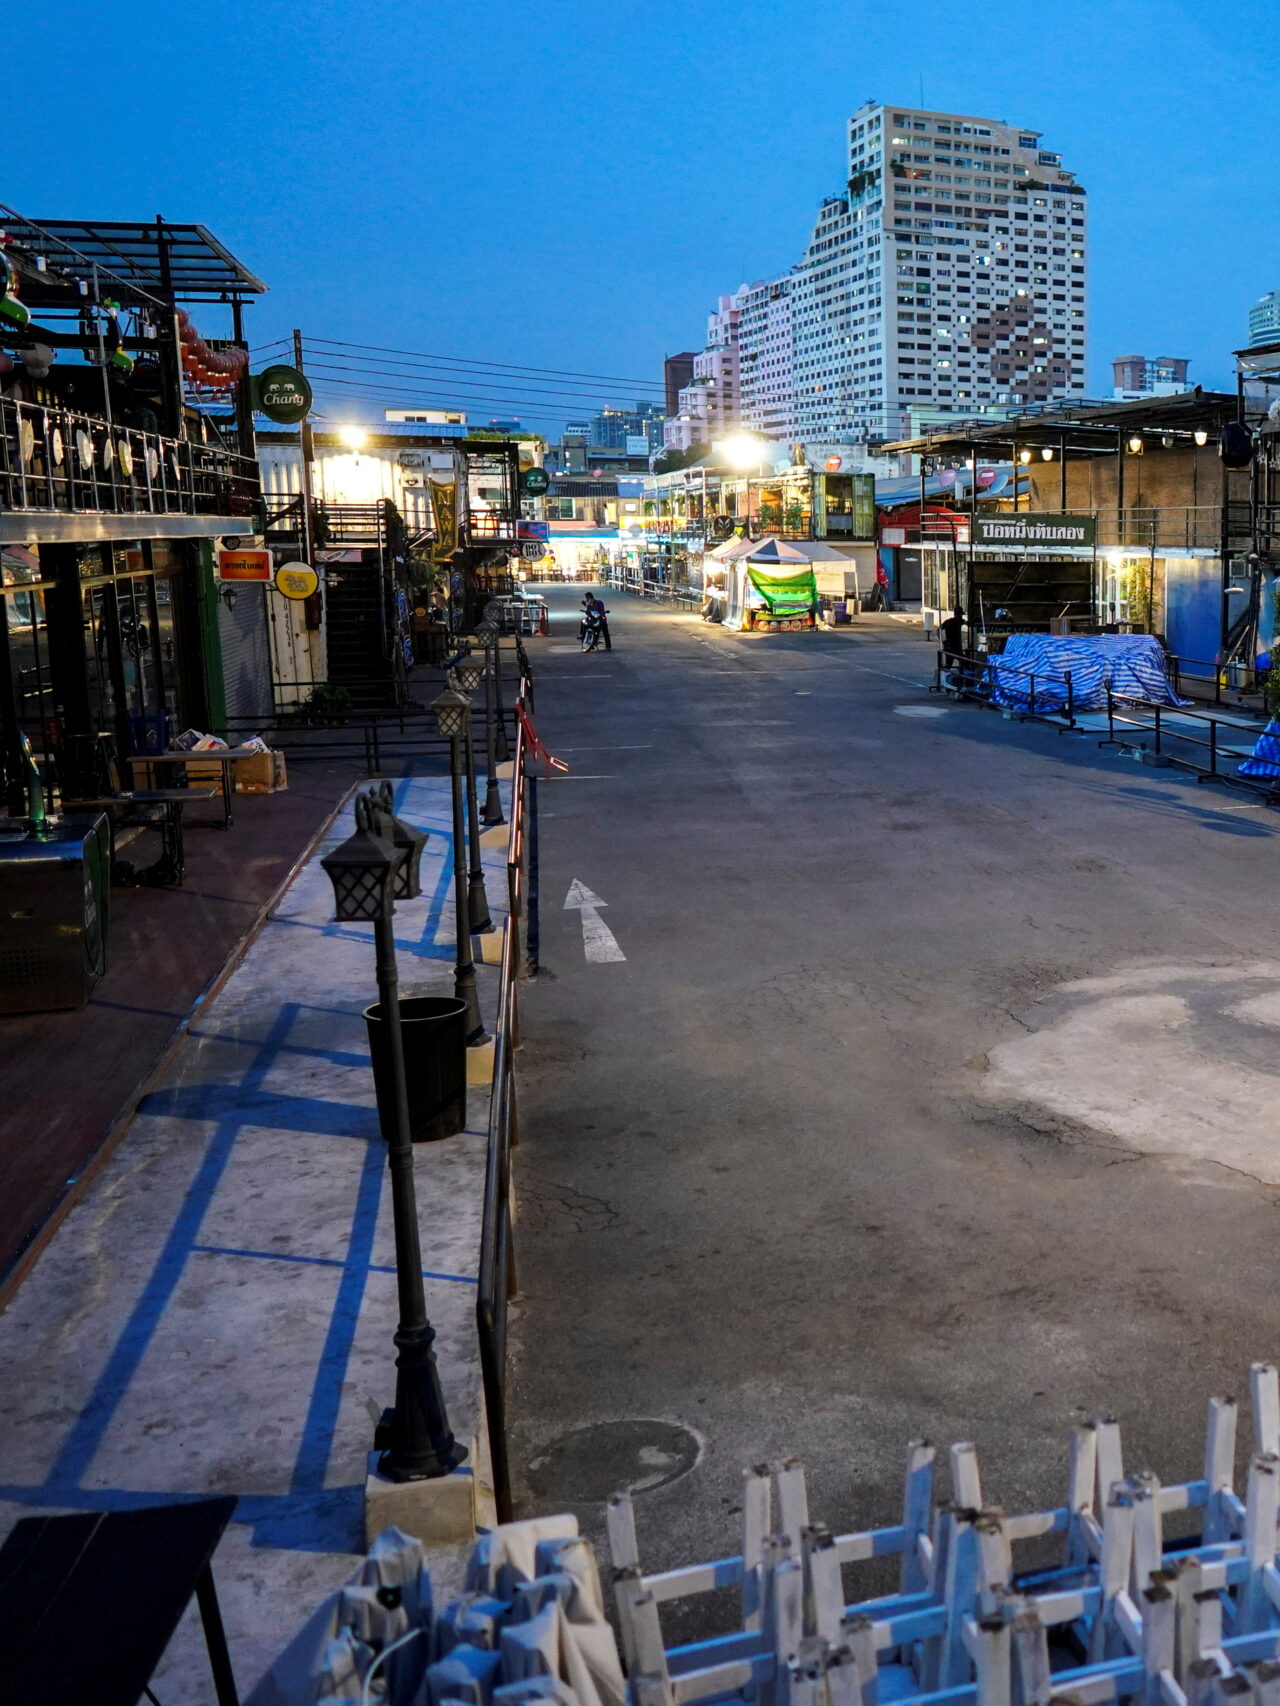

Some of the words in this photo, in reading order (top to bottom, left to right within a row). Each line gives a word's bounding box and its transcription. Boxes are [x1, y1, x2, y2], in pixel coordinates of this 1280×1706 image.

[263, 393, 304, 407] Chang
[982, 519, 1085, 540] ปอหนึ่งทับสอง
